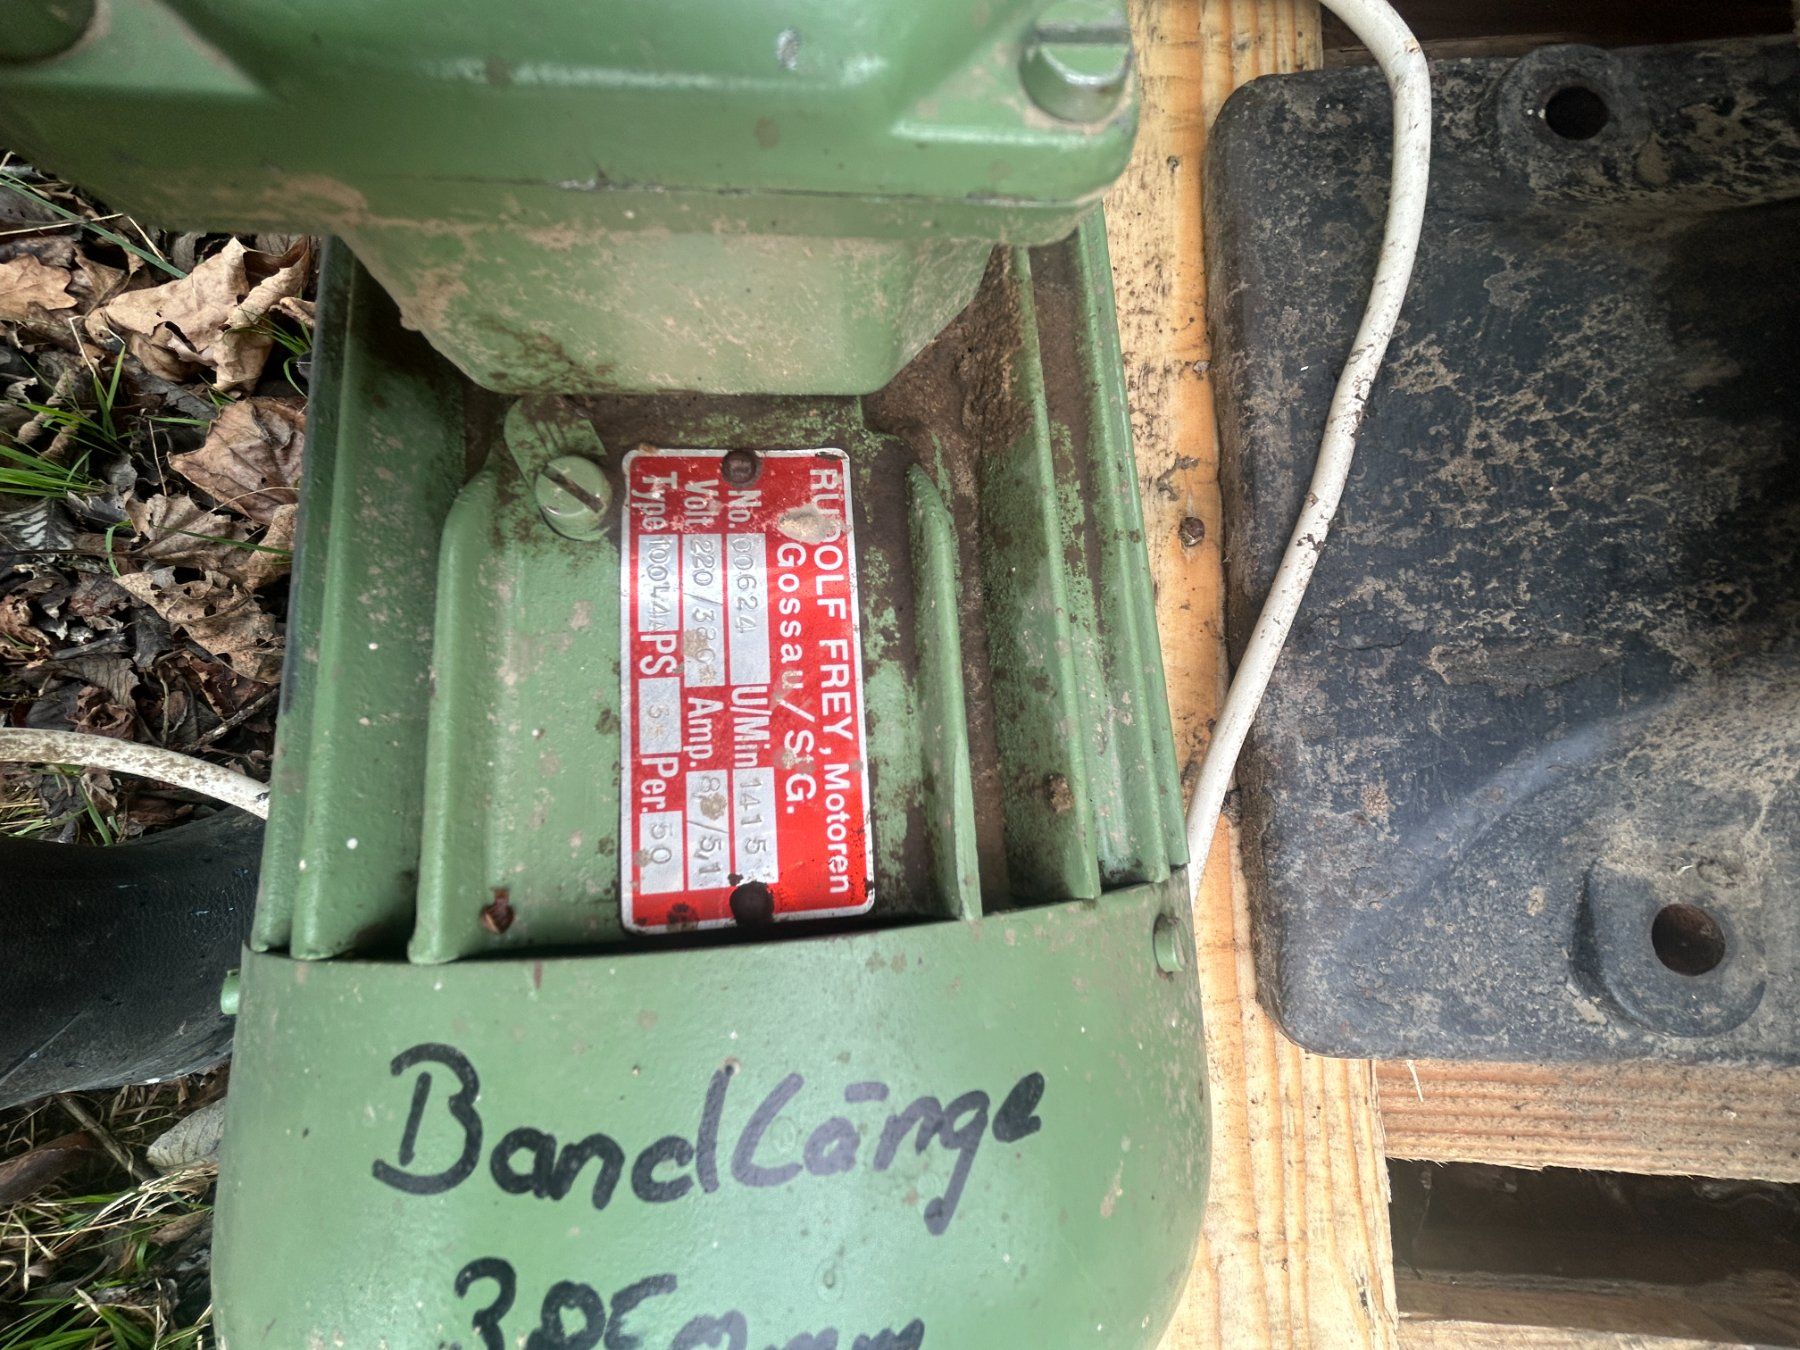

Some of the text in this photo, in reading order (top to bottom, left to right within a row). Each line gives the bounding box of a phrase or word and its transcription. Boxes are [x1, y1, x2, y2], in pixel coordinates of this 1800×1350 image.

[631, 472, 677, 531] Type
[684, 480, 719, 527] Volt
[639, 635, 676, 675] PS
[727, 490, 770, 855] No. 00624 U/Min 1415
[818, 639, 852, 756] FREY,
[685, 698, 723, 767] Amp.
[639, 757, 678, 812] Per.
[648, 822, 670, 865] 50
[688, 775, 727, 876] 8,/5,1
[823, 763, 851, 894] Motoren
